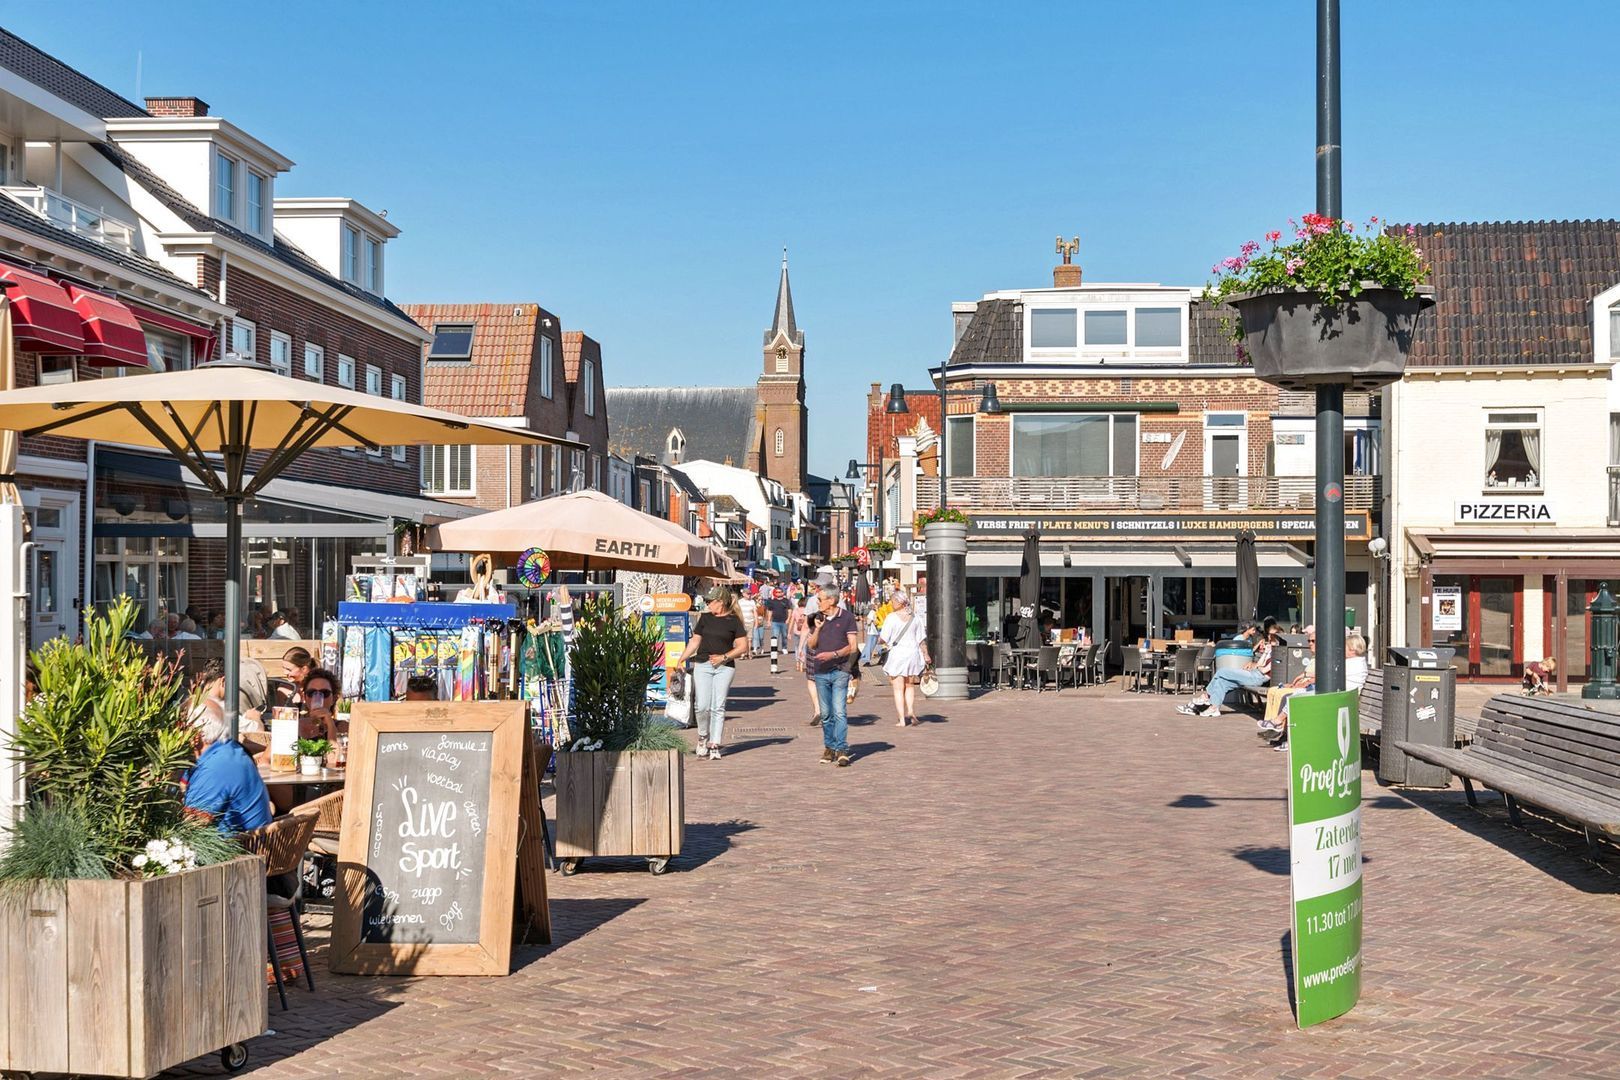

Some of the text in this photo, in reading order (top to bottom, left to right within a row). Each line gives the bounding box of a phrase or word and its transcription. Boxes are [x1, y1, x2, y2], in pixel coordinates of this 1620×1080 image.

[976, 520, 1007, 529] VERSE
[1009, 520, 1036, 529] FRIET
[1043, 521, 1071, 530] PLATE
[1074, 521, 1109, 530] MENU'S
[1116, 521, 1174, 530] SCHNITZELS
[1182, 521, 1207, 530] LUXE
[1209, 521, 1274, 530] HAMBURGERS
[595, 538, 657, 558] EARTH
[1300, 759, 1338, 798] Proef
[398, 787, 457, 838] Live
[399, 842, 462, 878] Sport
[1328, 854, 1340, 879] 17
[411, 887, 442, 905] ziggo
[1306, 911, 1334, 935] 11.30
[1334, 908, 1346, 927] tot
